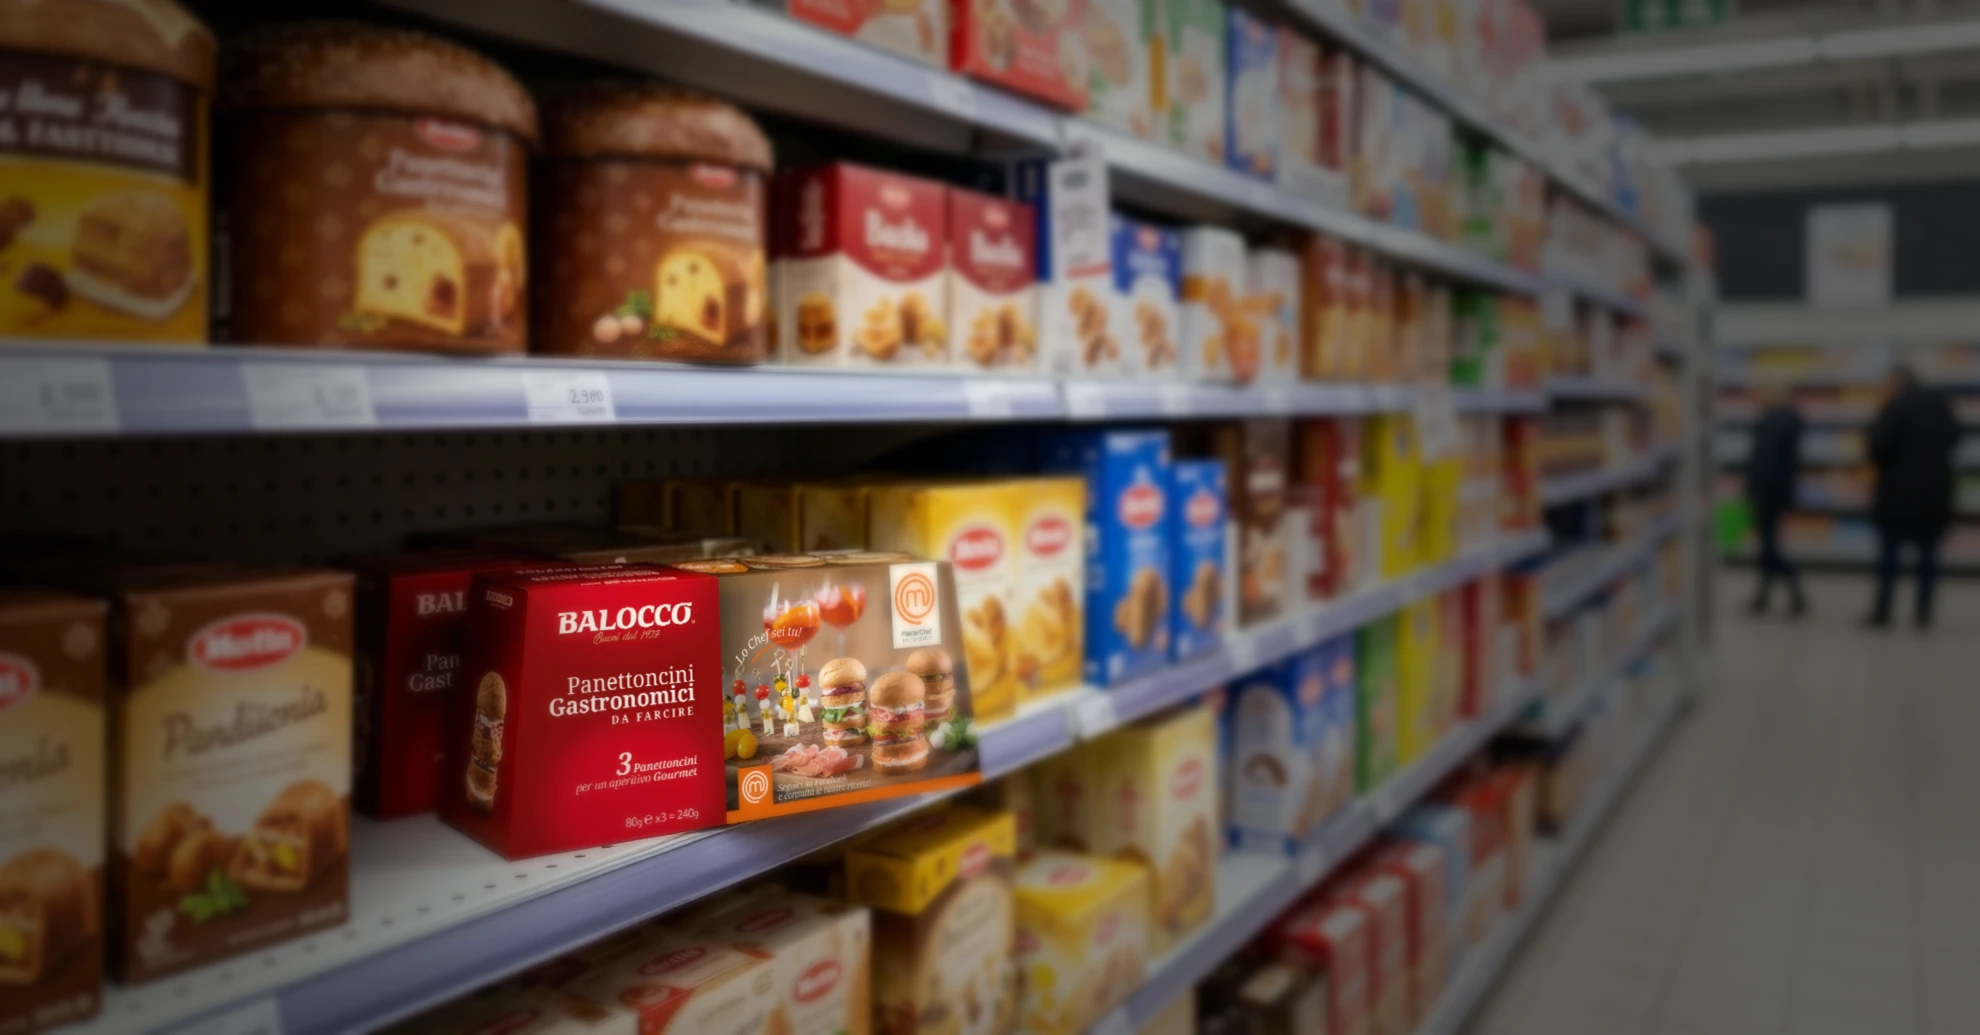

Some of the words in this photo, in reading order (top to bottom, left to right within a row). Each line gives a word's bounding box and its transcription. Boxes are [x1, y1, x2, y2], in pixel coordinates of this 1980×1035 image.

[416, 591, 468, 615] BAL
[557, 602, 693, 635] BALOCCO
[593, 631, 620, 644] Buoni
[622, 630, 637, 641] dal
[735, 649, 748, 664] Lo
[748, 628, 770, 650] Chef
[771, 626, 786, 638] sei
[788, 627, 803, 637] tu!
[426, 654, 460, 671] Pan
[409, 673, 454, 692] Gast
[567, 664, 695, 695] Panettoncini
[549, 682, 695, 717] Gastronomici
[611, 713, 630, 725] DA
[636, 706, 694, 722] FARCIRE
[616, 752, 632, 776] 3
[633, 755, 698, 773] Panettoncini
[575, 782, 594, 796] per
[594, 780, 607, 790] un
[609, 774, 651, 791] aperitivo
[653, 767, 698, 782] Gourmet
[625, 816, 643, 828] 80g
[655, 812, 667, 823] x3
[677, 808, 699, 820] 240g
